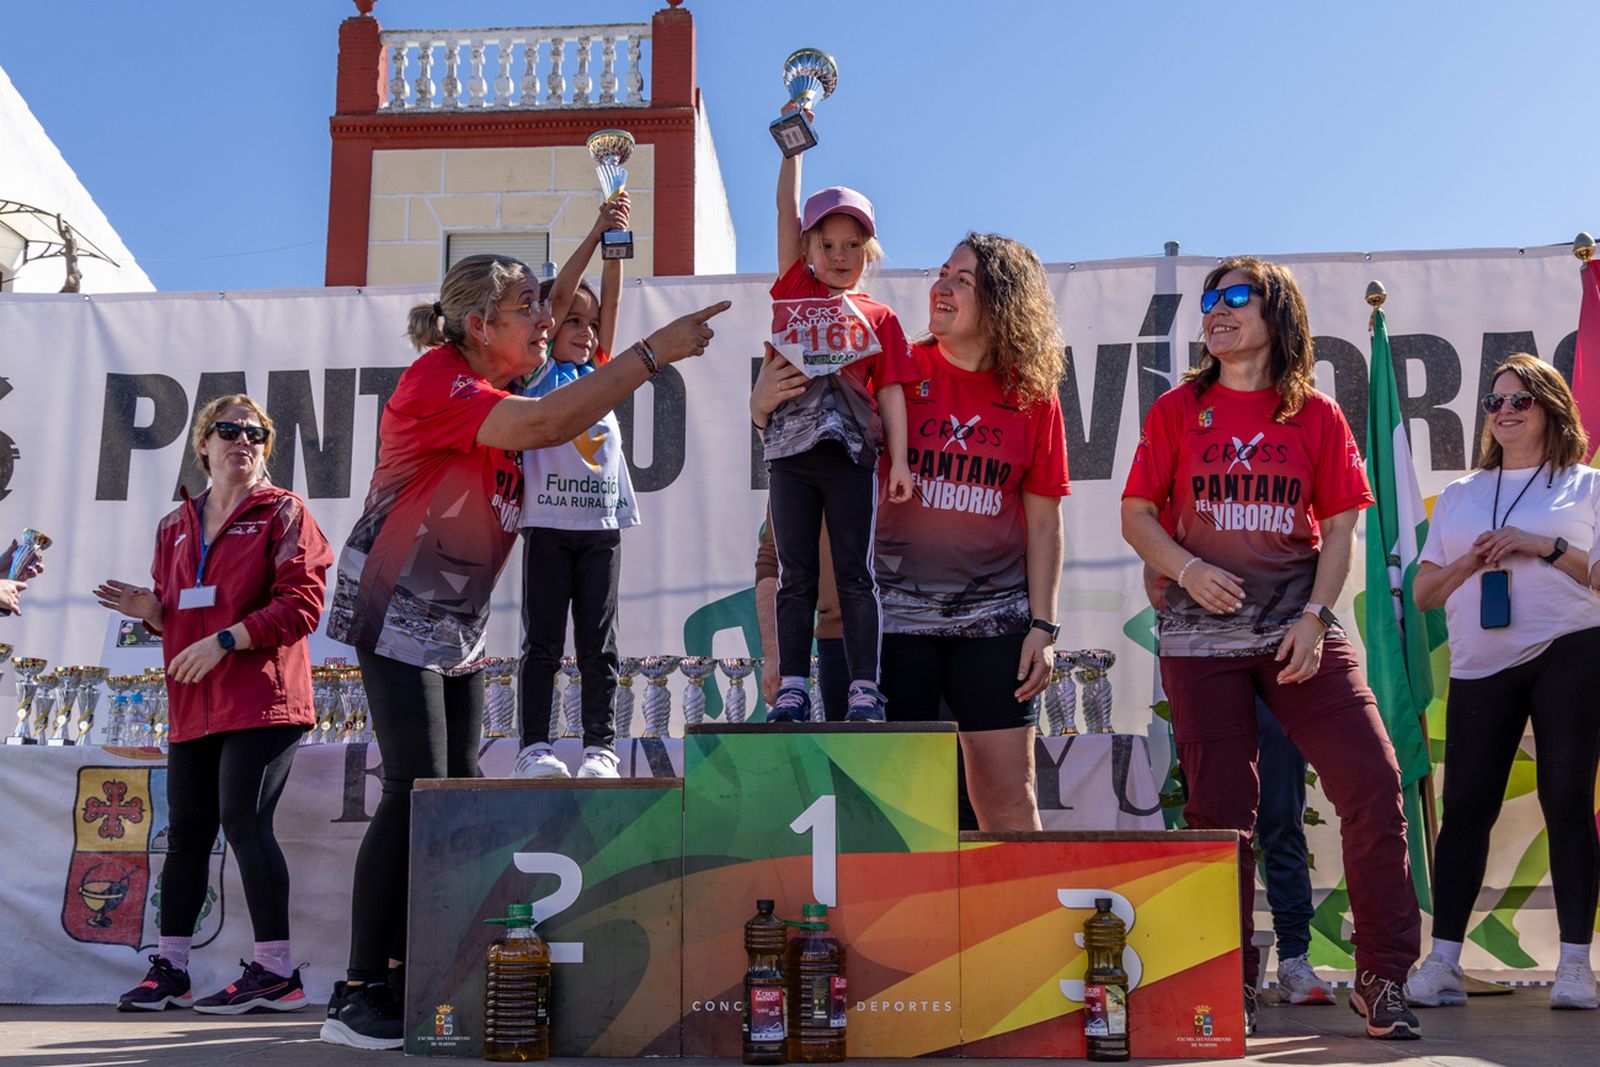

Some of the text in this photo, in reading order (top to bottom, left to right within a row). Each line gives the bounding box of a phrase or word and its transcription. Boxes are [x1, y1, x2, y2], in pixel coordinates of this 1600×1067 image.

[805, 306, 841, 318] CRO
[784, 321, 870, 352] 1160
[919, 418, 1004, 447] CROSS
[907, 447, 1012, 487] PANTANO
[1202, 442, 1289, 464] CROSS
[546, 474, 618, 494] Fundació
[921, 474, 1003, 517] VÍBORAS
[1192, 473, 1302, 506] PANTANO
[537, 494, 568, 507] CAJA
[571, 496, 607, 510] RURAL
[1212, 496, 1296, 536] VÍBORAS
[789, 795, 837, 908] 1
[512, 852, 584, 964] 2
[1057, 888, 1144, 1003] 3
[856, 1001, 953, 1013] DEPORTES
